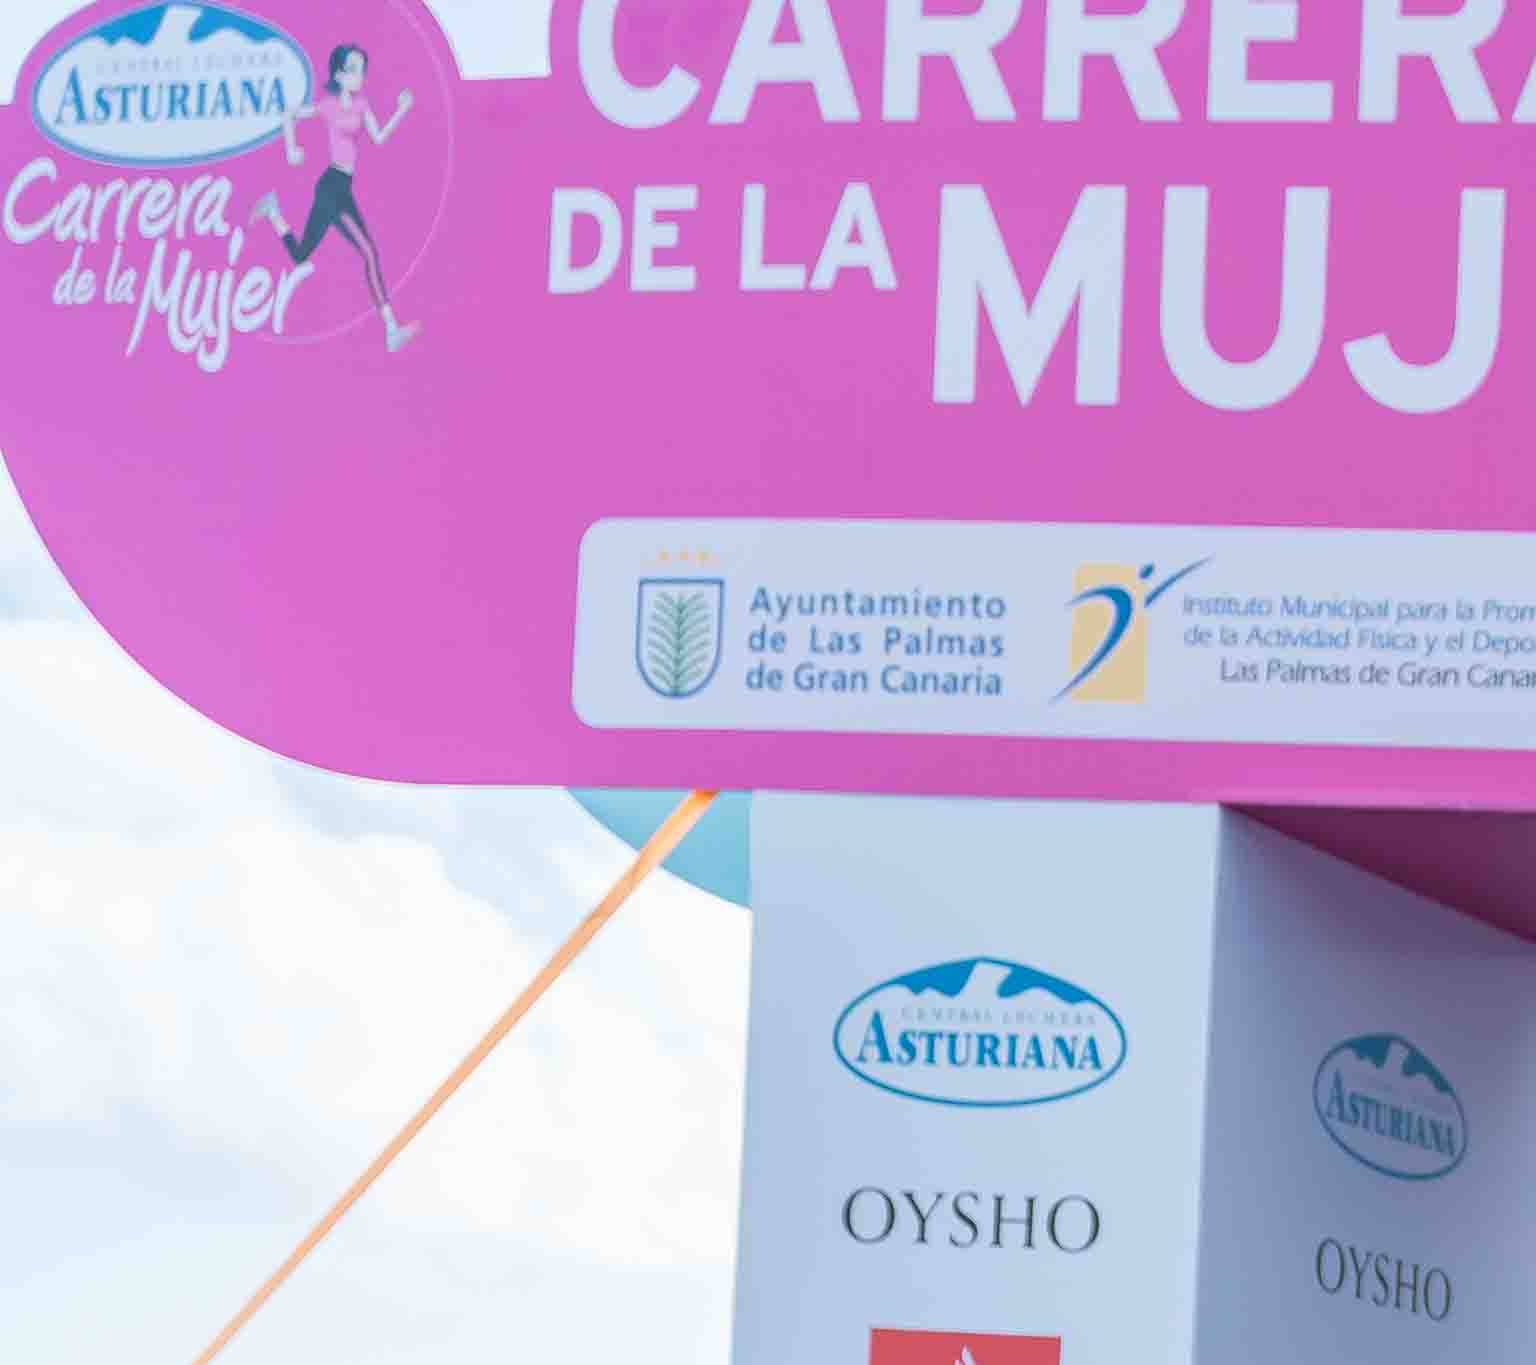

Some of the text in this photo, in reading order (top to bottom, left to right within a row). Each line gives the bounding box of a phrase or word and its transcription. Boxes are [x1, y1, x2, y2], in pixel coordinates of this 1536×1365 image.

[55, 66, 290, 126] ASTURIANA
[2, 157, 233, 245] Carrera
[548, 186, 698, 294] DE
[740, 182, 898, 292] LA
[52, 228, 315, 373] de la Mujer
[749, 586, 1006, 628] Ayuntamiento
[1182, 594, 1273, 619] Instituto
[1280, 596, 1391, 624] Municipal
[1397, 603, 1449, 625] para
[1456, 599, 1475, 622] la
[748, 624, 1005, 659] de Las Palmas
[1184, 625, 1214, 648] de
[1220, 626, 1241, 648] la
[1246, 627, 1352, 651] Actividad
[1425, 636, 1438, 658] y
[1444, 631, 1466, 653] el
[745, 662, 1002, 698] de Gran Canaria
[1220, 659, 1259, 684] Las
[1265, 660, 1352, 685] Palmas
[1359, 662, 1390, 686] de
[1397, 664, 1460, 689] Gran
[856, 1010, 1103, 1070] ASTURIANA
[1327, 1067, 1457, 1157] ASTURIANA
[842, 1186, 1101, 1253] OYSHO
[1315, 1237, 1452, 1321] OYSHO
